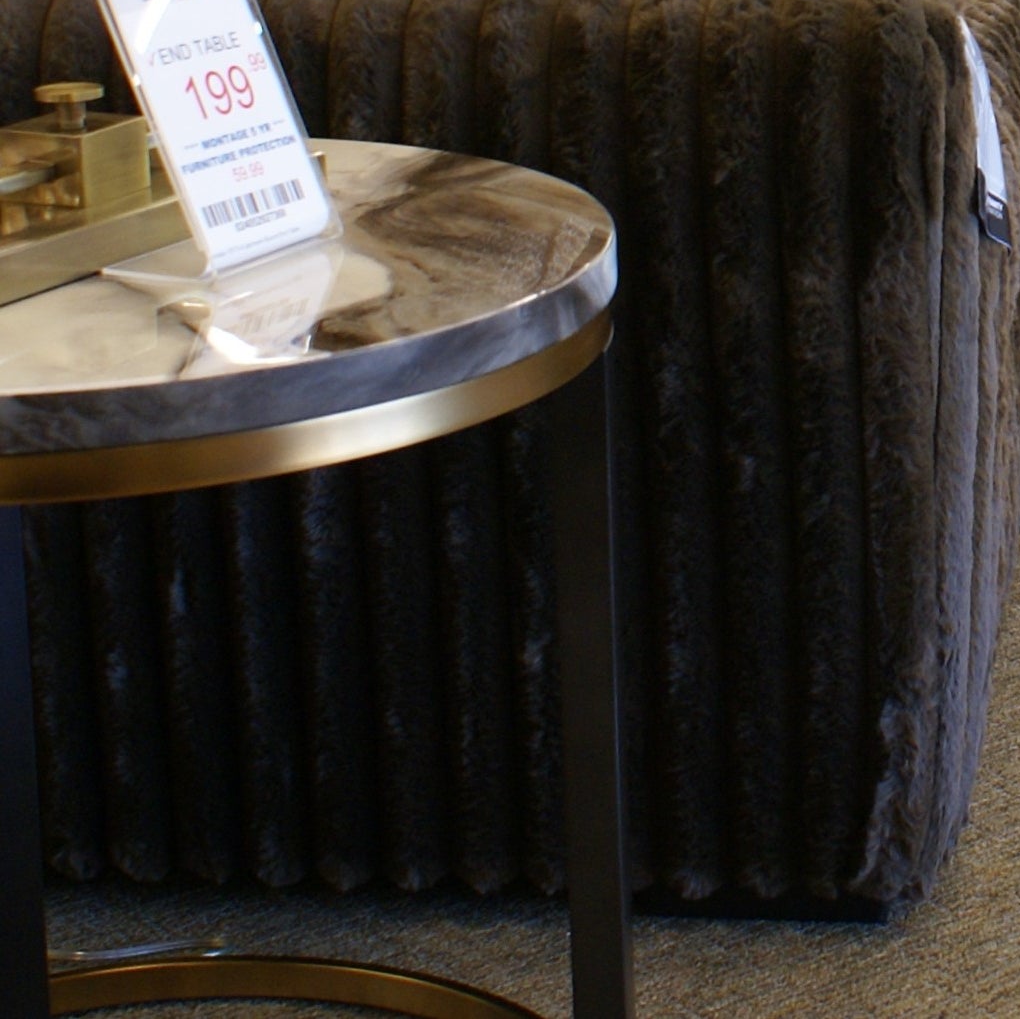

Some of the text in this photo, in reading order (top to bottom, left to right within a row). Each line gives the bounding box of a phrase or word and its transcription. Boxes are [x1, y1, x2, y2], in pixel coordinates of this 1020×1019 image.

[158, 31, 241, 66] END TABLE
[185, 65, 255, 120] 199
